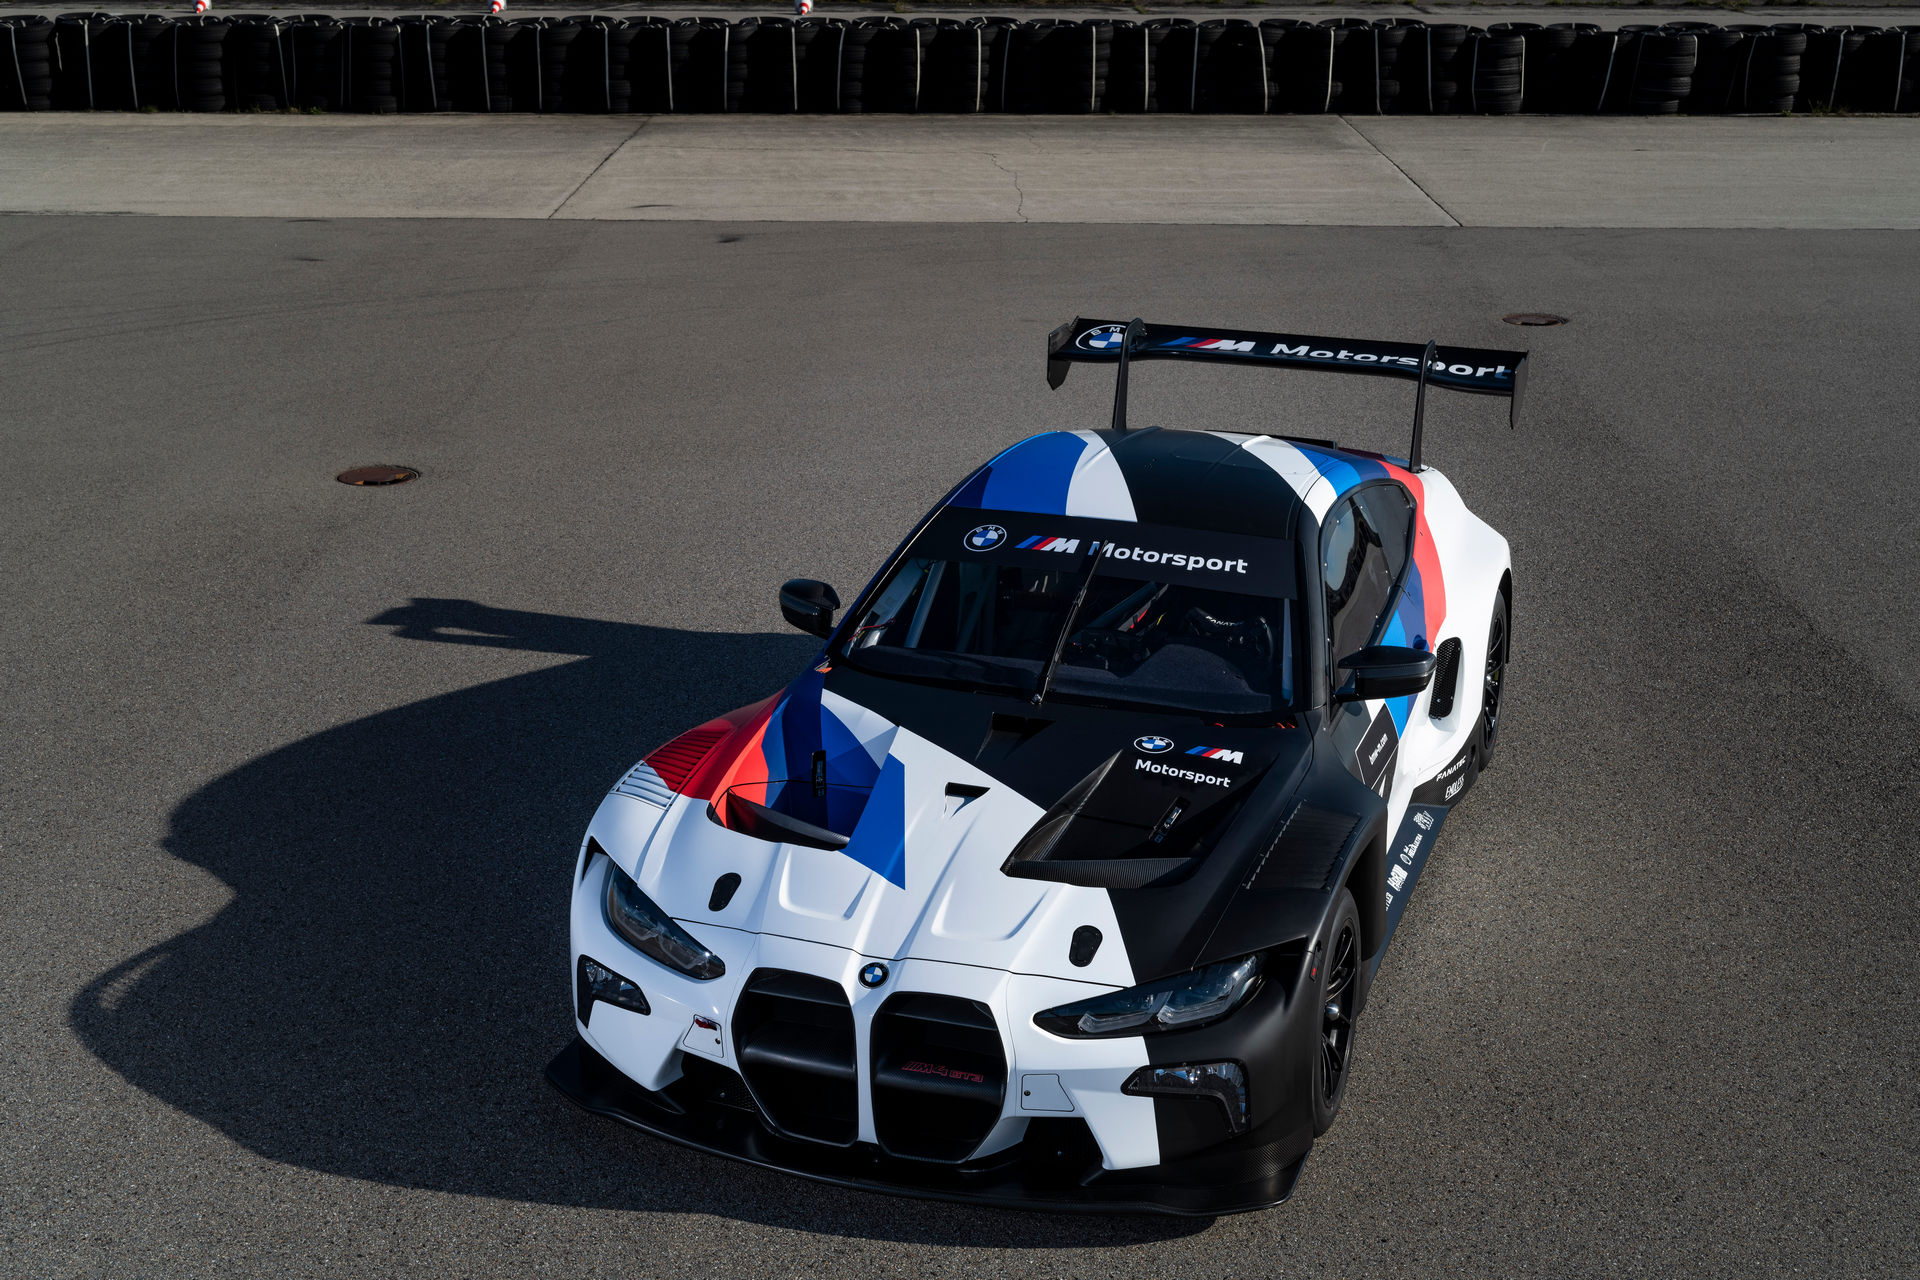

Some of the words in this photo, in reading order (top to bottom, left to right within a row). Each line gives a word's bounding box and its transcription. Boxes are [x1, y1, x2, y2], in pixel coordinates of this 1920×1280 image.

[1088, 540, 1249, 574] Motorsport
[1135, 758, 1232, 787] Motorsport
[1436, 754, 1467, 783] FANATEC
